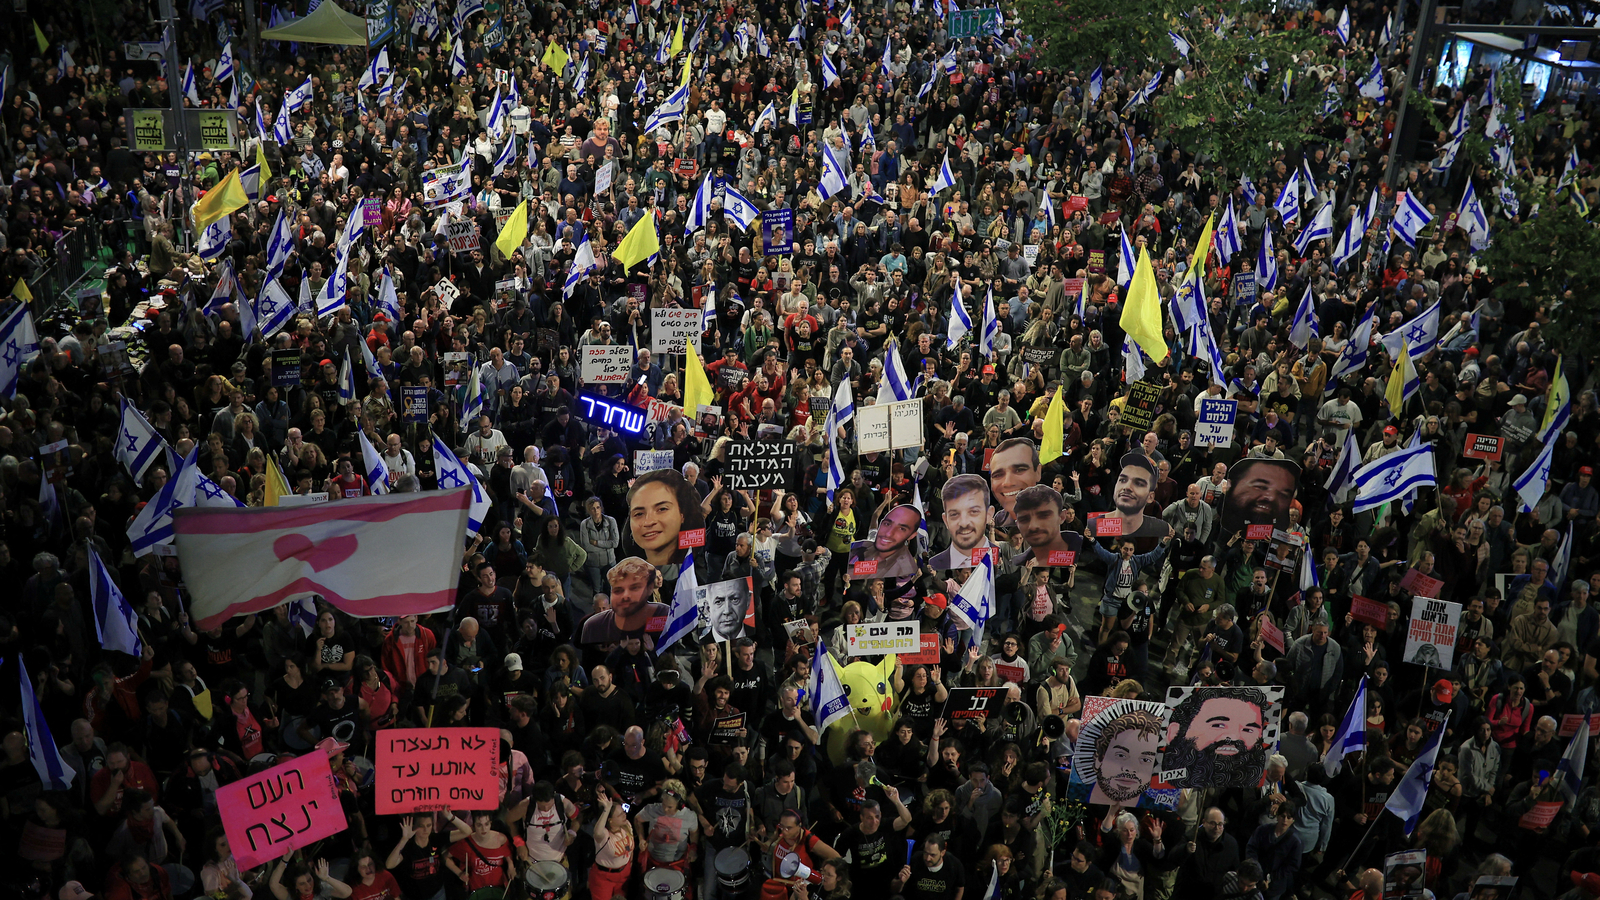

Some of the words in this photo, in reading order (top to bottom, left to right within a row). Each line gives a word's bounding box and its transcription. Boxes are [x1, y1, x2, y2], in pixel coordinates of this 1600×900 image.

[137, 127, 161, 139] אשם
[202, 127, 227, 139] אשם
[137, 137, 163, 147] במחדל
[202, 137, 229, 147] במחדל
[588, 349, 606, 357] הזה
[609, 346, 629, 356] בשלב
[618, 357, 630, 365] אני
[603, 363, 618, 374] יכול
[414, 397, 426, 405] בעד
[1133, 390, 1157, 403] נתניהו
[895, 401, 919, 412] מורשת
[1138, 399, 1148, 409] או
[1205, 401, 1233, 413] הגליל
[580, 395, 645, 435] שחרר
[894, 409, 918, 418] נתניהו
[871, 421, 888, 431] בתי
[1122, 413, 1150, 427] החטופים
[1209, 424, 1222, 434] על
[863, 430, 888, 441] קברות
[1199, 433, 1228, 444] ישראל
[1476, 436, 1498, 446] מדינה
[1473, 442, 1498, 453] חטופה
[730, 456, 793, 472] המדינה
[724, 472, 786, 491] מעצמך
[685, 528, 704, 539] עדיין
[1426, 600, 1447, 614] אתה
[1420, 609, 1449, 625] הראש
[1410, 618, 1433, 631] אשם
[1434, 623, 1456, 636] אתה
[869, 626, 889, 637] עם
[896, 626, 914, 637] מה
[858, 638, 914, 650] החטופים
[976, 689, 998, 698] קודם
[967, 695, 989, 711] כל
[390, 735, 449, 754] תעצרו
[461, 734, 486, 751] לא
[391, 761, 421, 779] עד
[430, 760, 477, 777] אותנו
[1159, 769, 1184, 784] איתן
[246, 768, 305, 810] העם
[390, 786, 440, 804] חוזרים
[449, 786, 484, 802] שהם
[1155, 793, 1174, 805] אלון
[245, 799, 319, 852] ינצח
